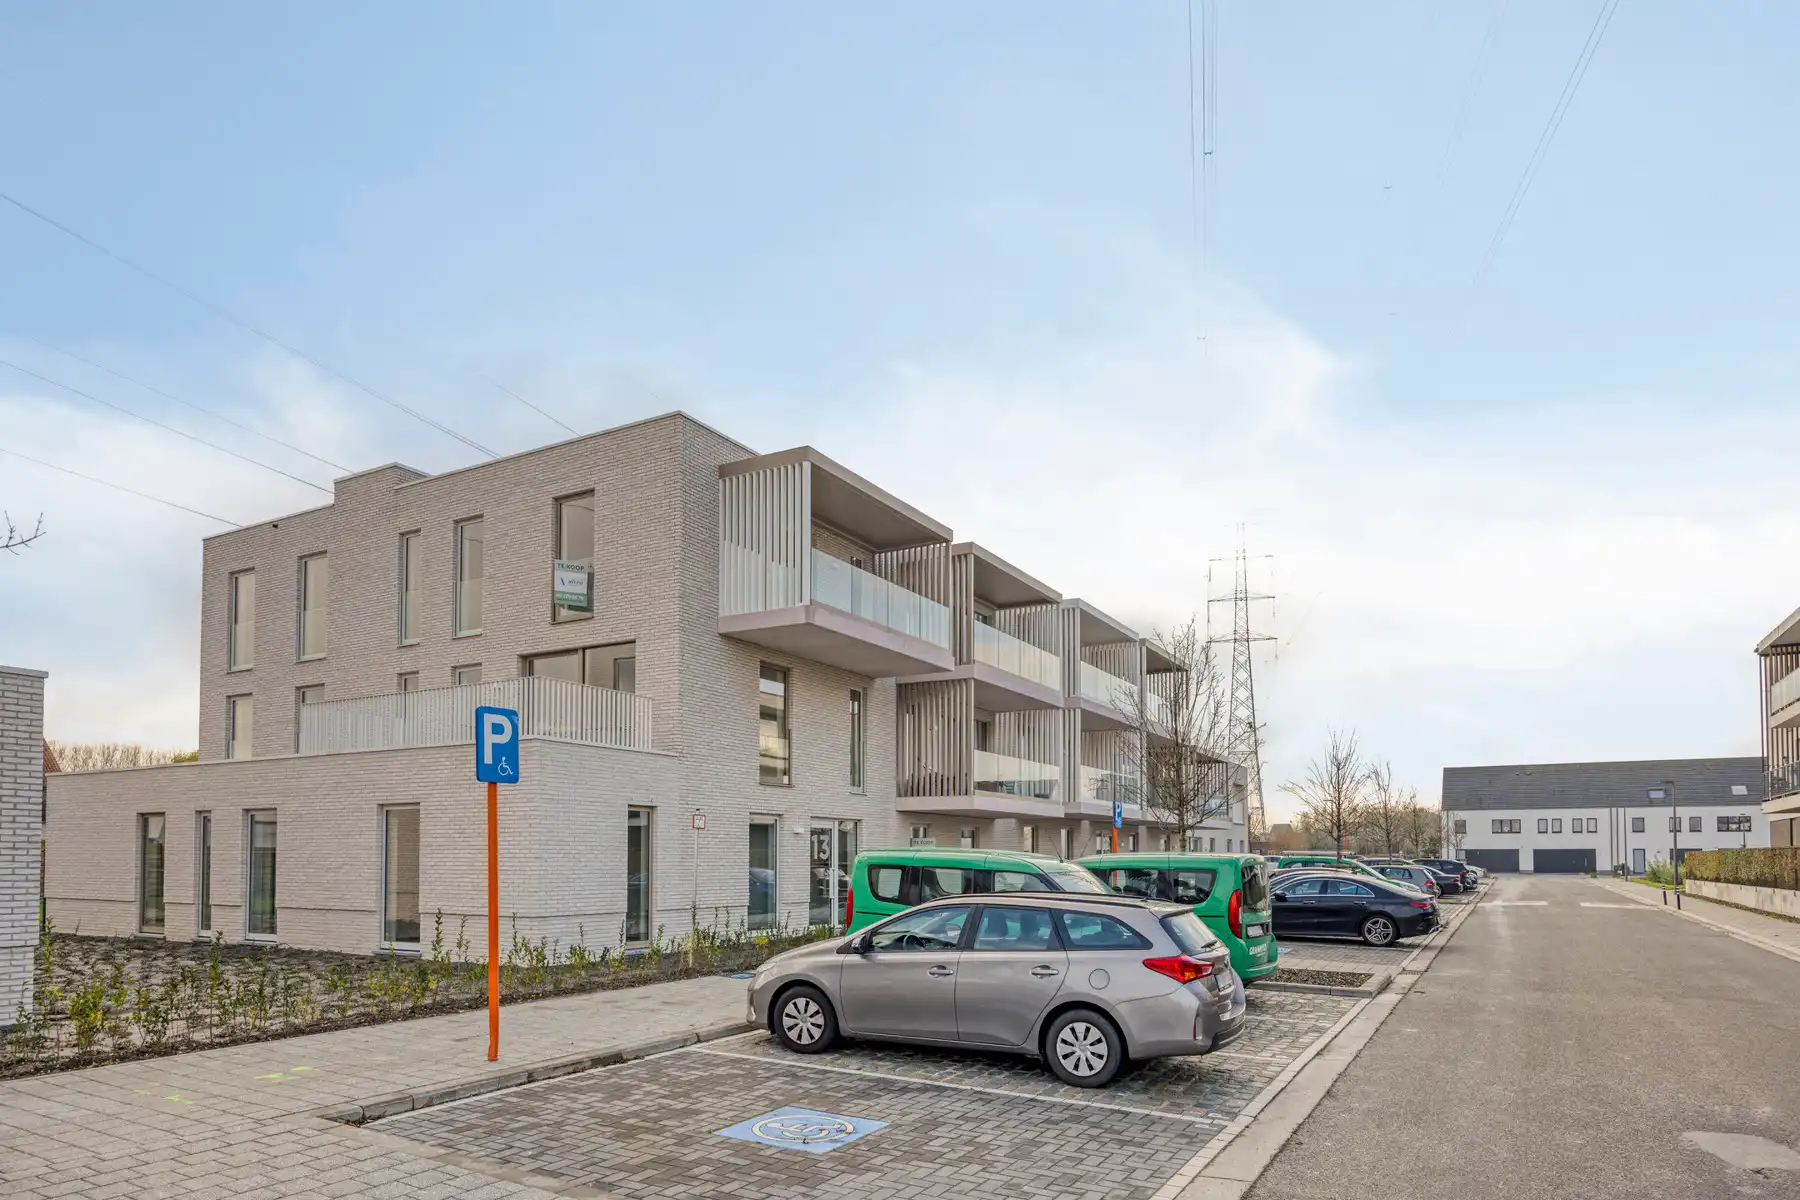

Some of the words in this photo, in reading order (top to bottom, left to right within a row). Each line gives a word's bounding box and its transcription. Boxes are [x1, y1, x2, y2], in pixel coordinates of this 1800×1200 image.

[483, 713, 512, 764] P
[1115, 801, 1121, 820] P
[811, 834, 830, 860] 13
